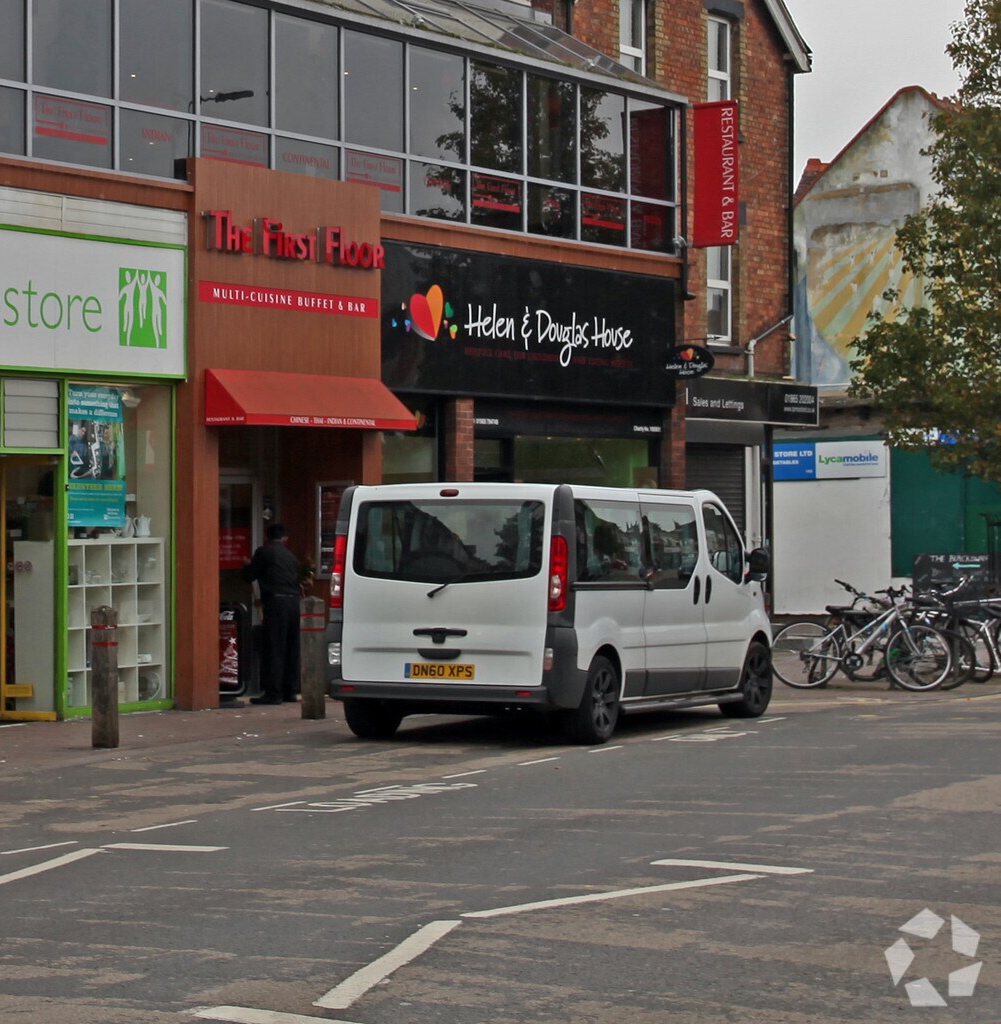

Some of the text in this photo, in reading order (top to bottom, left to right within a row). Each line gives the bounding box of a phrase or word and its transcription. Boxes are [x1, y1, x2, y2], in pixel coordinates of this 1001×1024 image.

[282, 151, 331, 170] CONTINENTAL
[720, 107, 735, 238] RESTAURANT & BAR
[3, 279, 103, 333] store
[212, 287, 366, 313] MULTI-CUISINE BUFFET & BAR
[464, 303, 515, 340] Helen
[521, 306, 533, 350] &
[536, 310, 589, 367] Douglas
[591, 316, 634, 351] House
[693, 396, 744, 411] Sales and Lettings
[818, 452, 879, 465] Lycamobile
[412, 664, 472, 677] DN60 XPS
